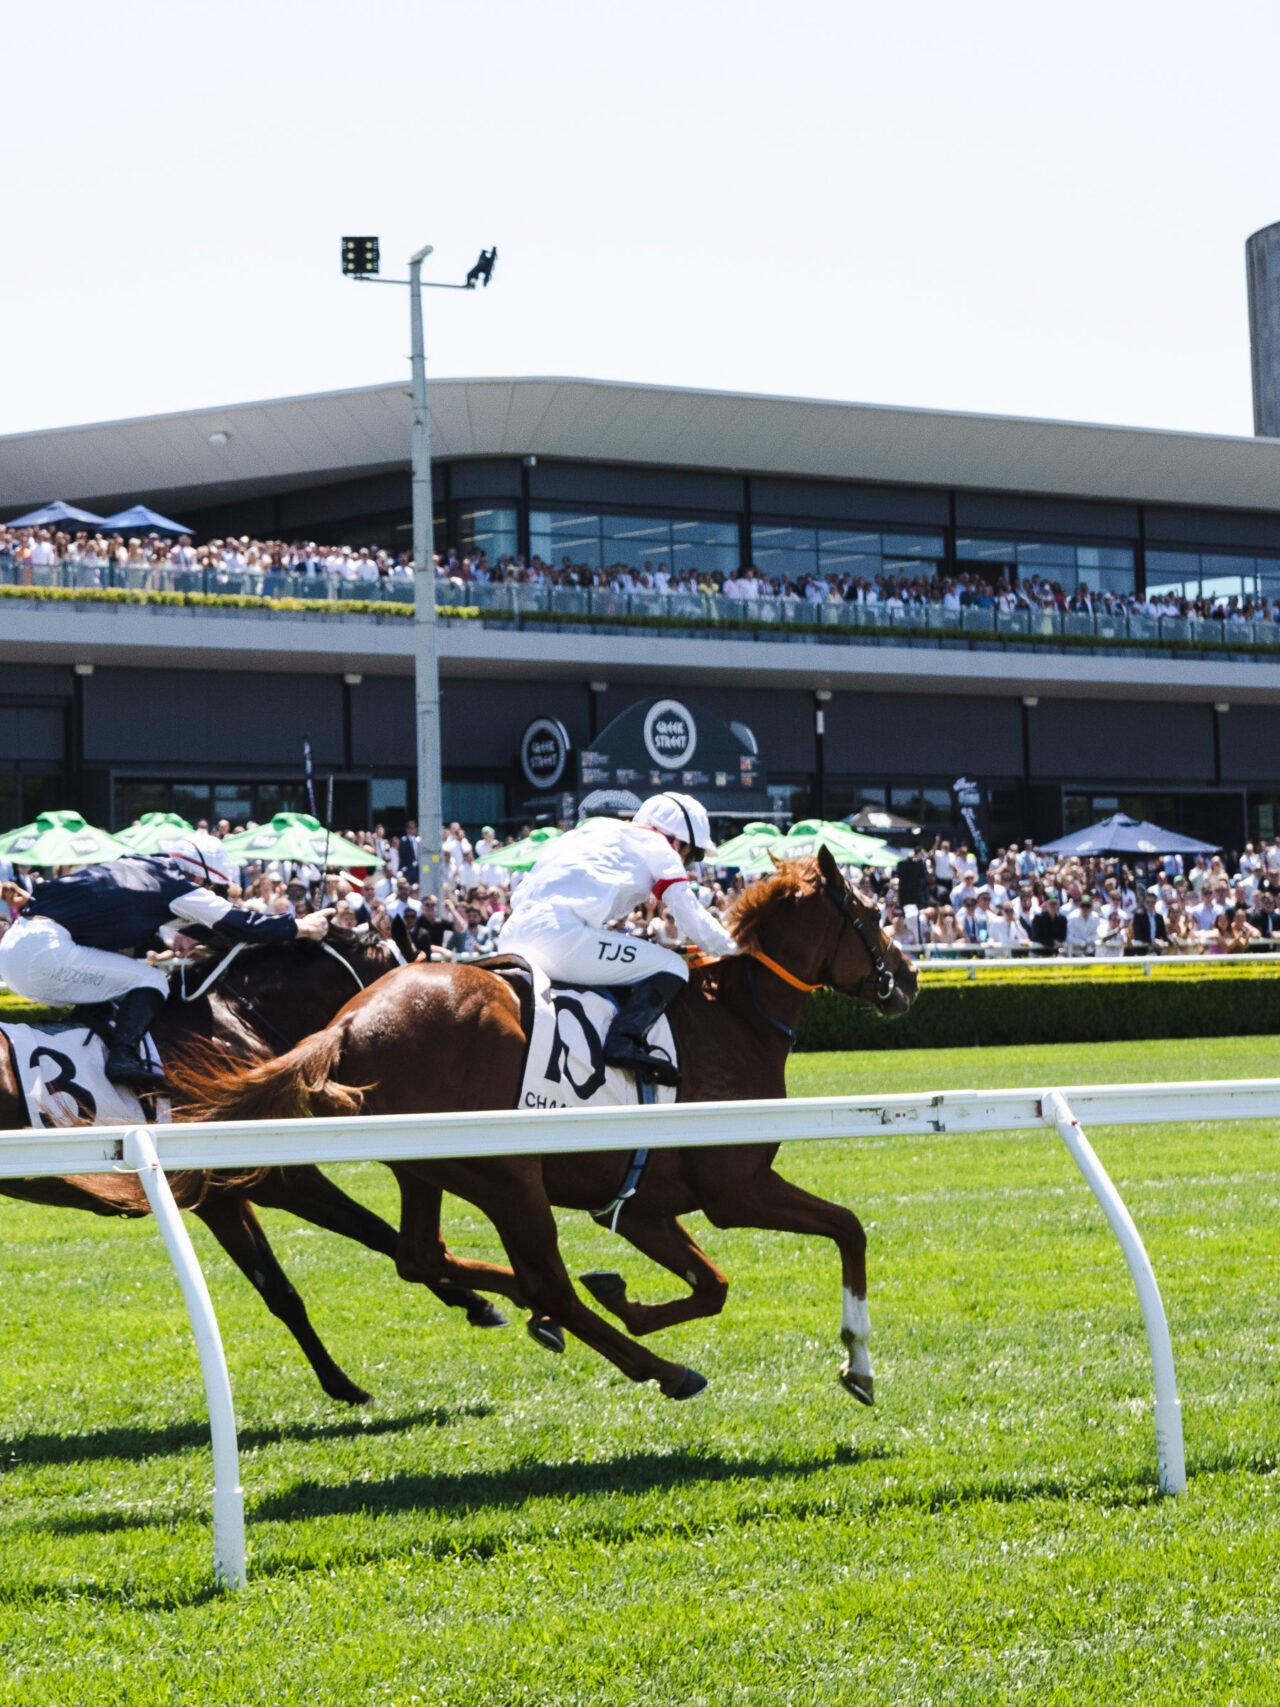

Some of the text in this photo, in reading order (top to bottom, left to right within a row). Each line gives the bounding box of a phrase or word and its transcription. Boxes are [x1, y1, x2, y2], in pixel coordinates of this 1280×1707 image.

[655, 721, 684, 734] GREEK
[655, 735, 686, 748] STREET
[598, 941, 637, 963] TJS
[30, 1046, 97, 1128] 3
